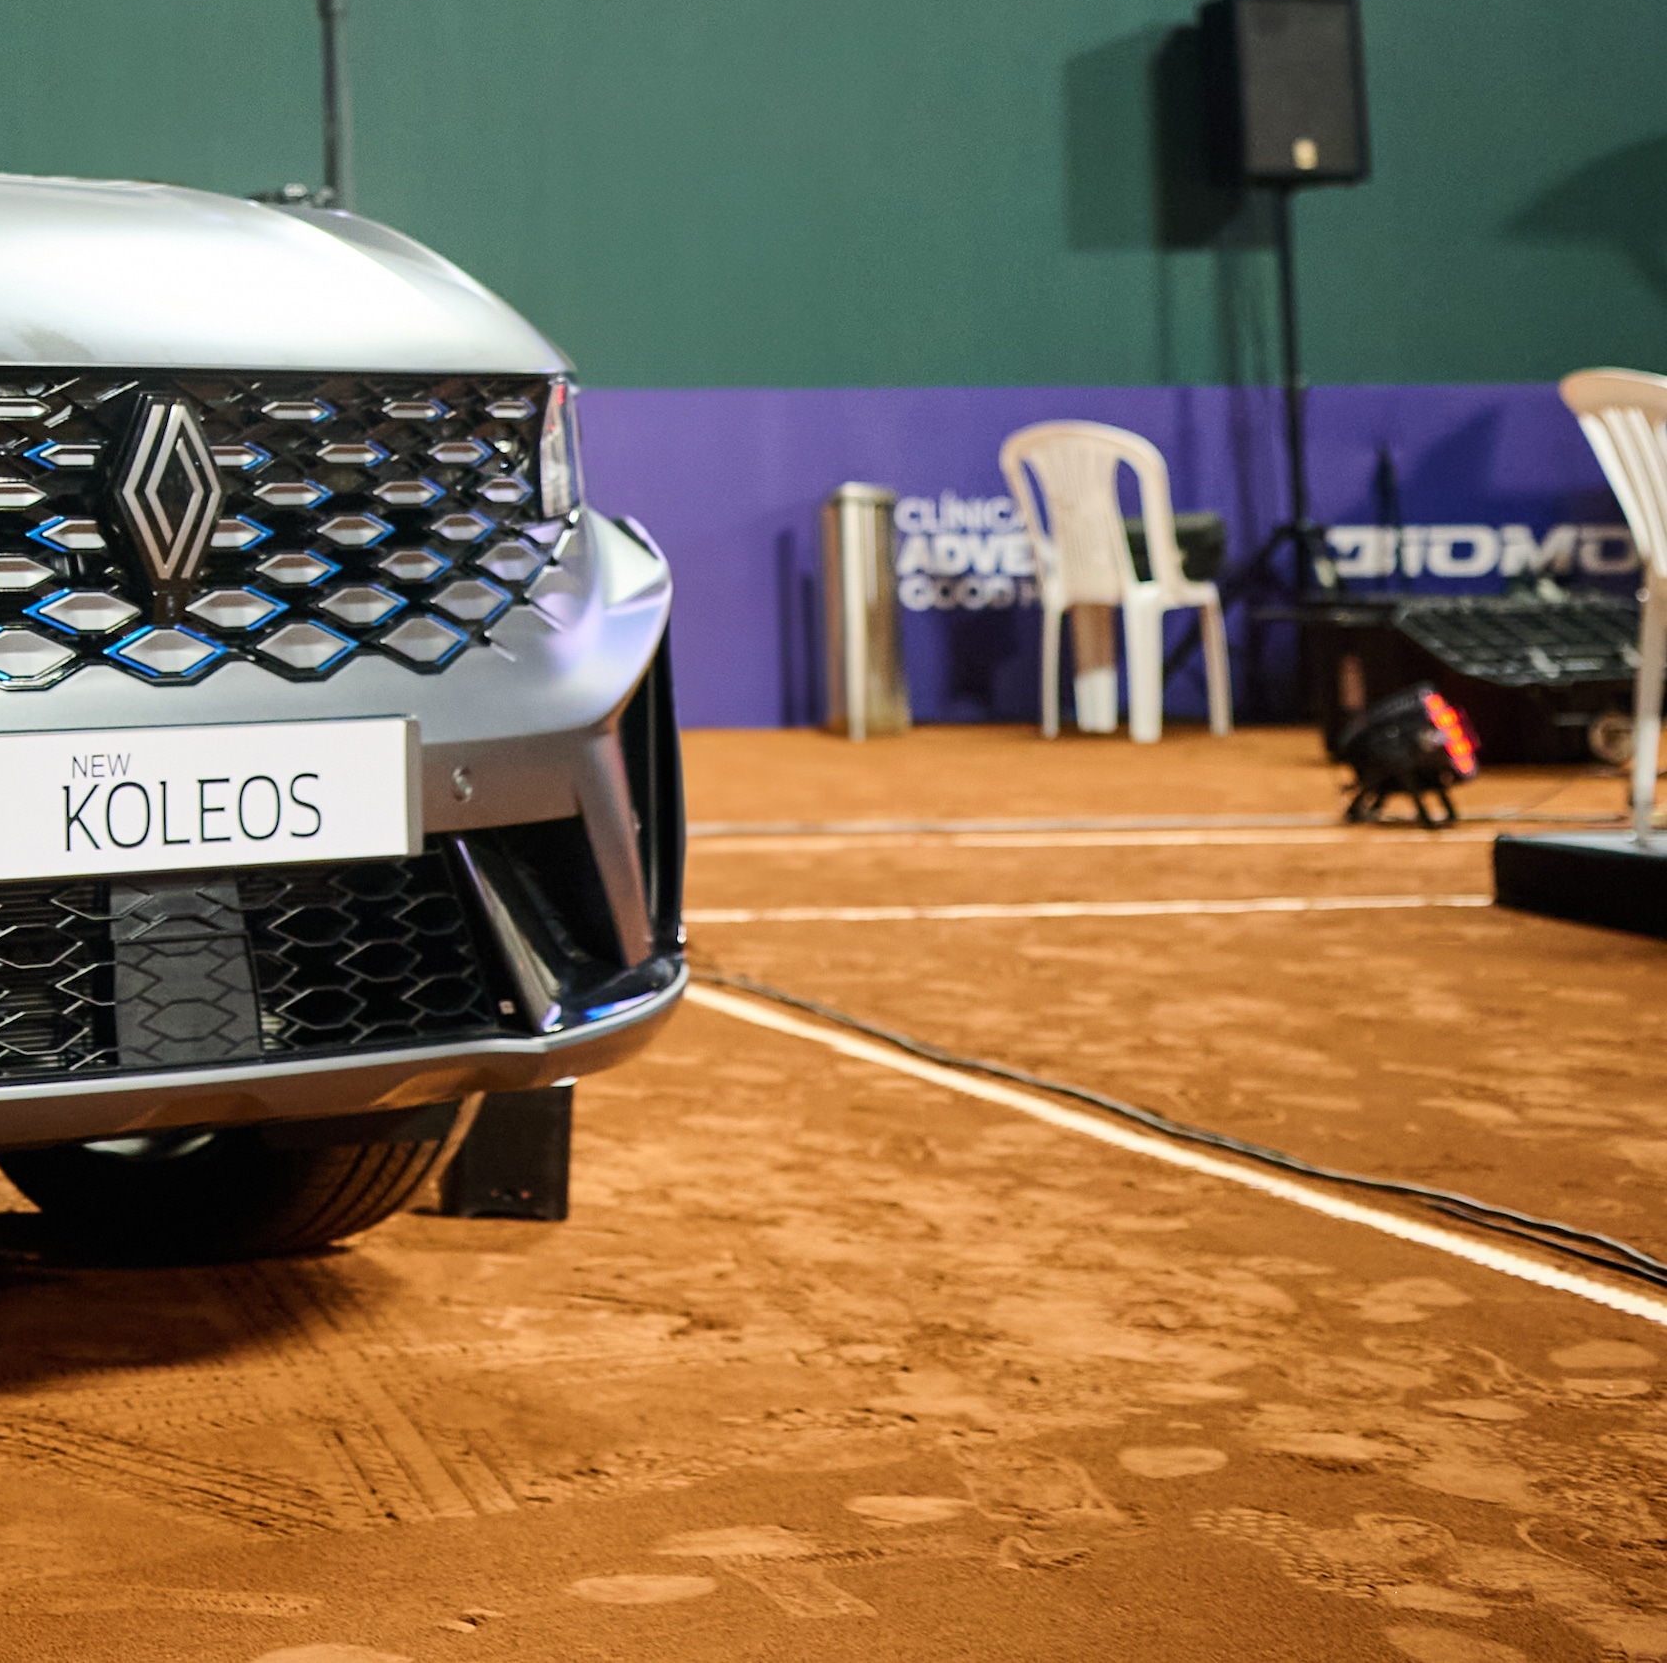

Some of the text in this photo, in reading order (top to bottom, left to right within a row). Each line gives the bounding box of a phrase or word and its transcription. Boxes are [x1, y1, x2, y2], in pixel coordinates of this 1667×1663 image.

[897, 534, 1039, 576] ADVE
[71, 753, 131, 779] NEW
[62, 772, 323, 852] KOLEOS
